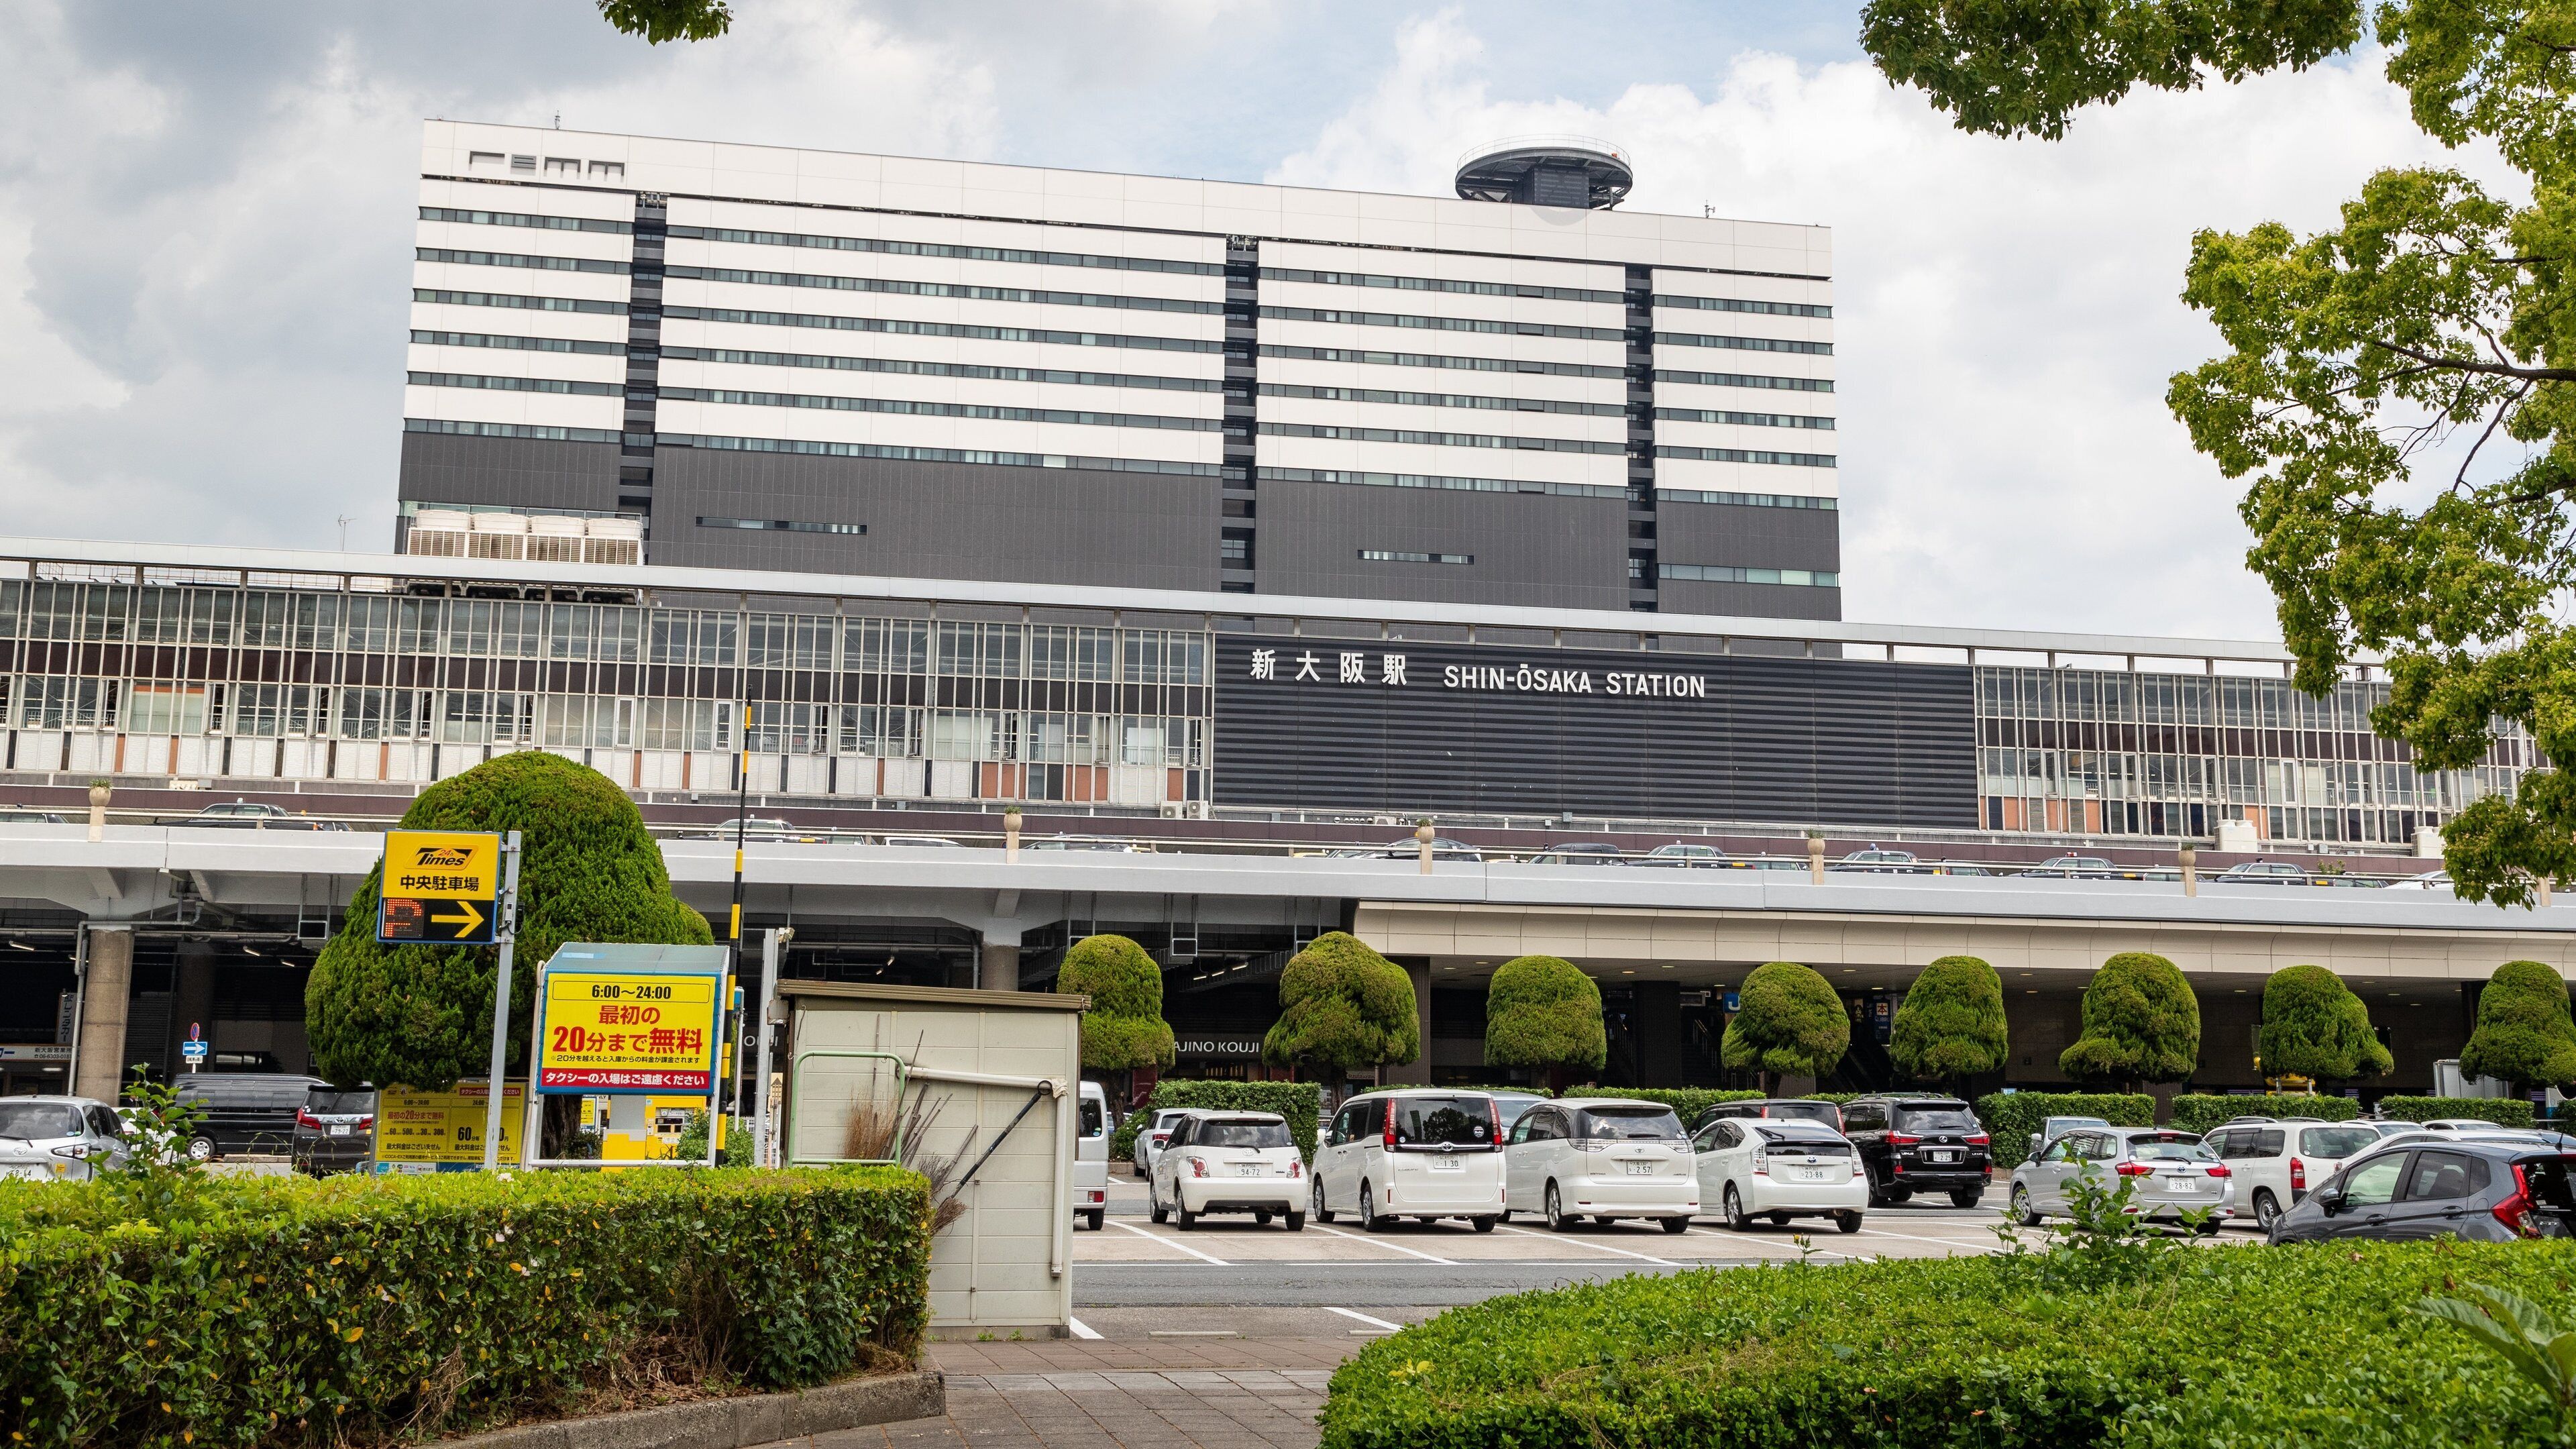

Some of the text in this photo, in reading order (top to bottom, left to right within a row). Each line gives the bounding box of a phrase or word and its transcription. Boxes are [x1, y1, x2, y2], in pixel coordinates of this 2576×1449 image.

[1250, 648, 1407, 686] 新大阪駅
[1444, 663, 1705, 698] SHIN-ŌSAKA STATION
[417, 851, 466, 866] Times
[400, 874, 480, 892] 中央駐車場
[592, 984, 672, 1000] 6:00～24:00
[598, 1005, 661, 1026] 最初の
[1877, 1004, 1888, 1014] 本
[552, 1026, 703, 1055] 20分まで無料
[1218, 1042, 1259, 1053] KOUJI
[545, 1072, 705, 1086] タクシーの入場はご遠慮ください
[387, 1110, 444, 1120] 最初の20分まで無料
